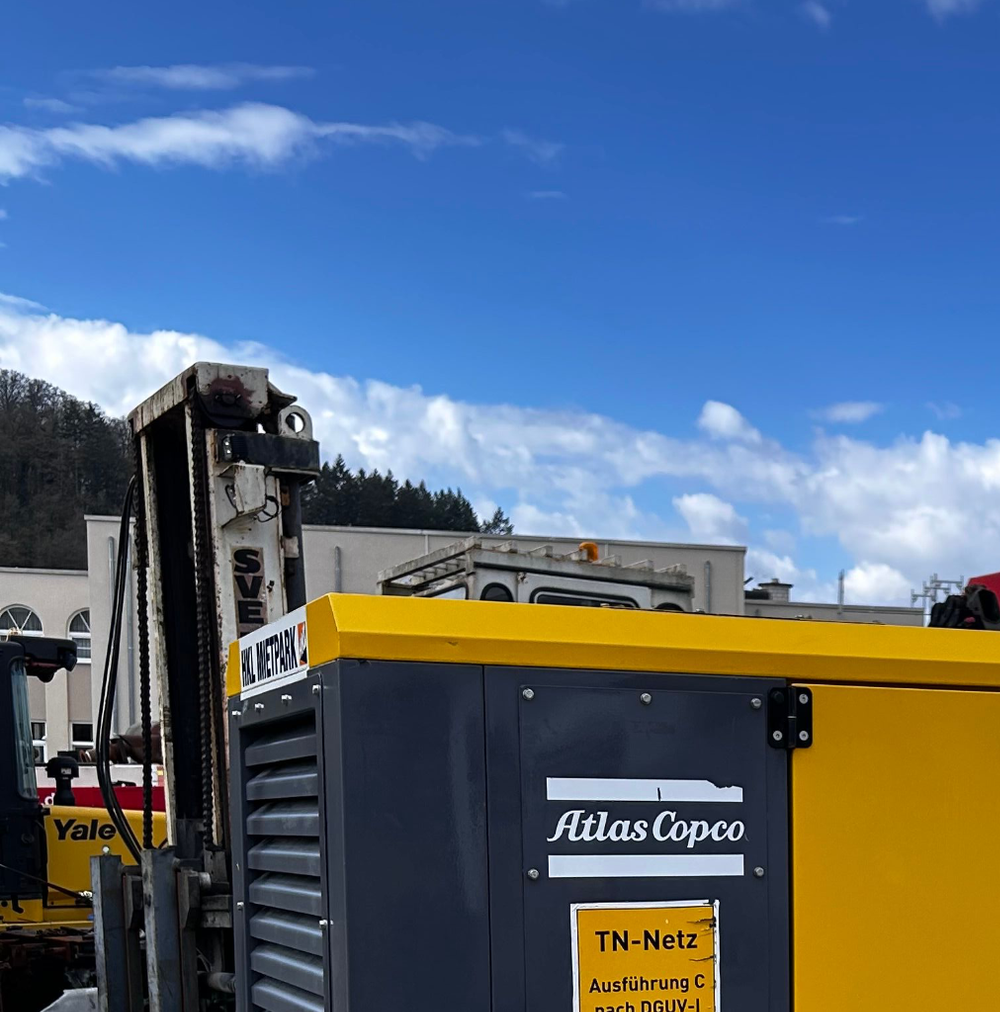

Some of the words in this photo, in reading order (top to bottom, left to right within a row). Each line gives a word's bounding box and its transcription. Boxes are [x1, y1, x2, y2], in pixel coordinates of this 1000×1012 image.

[233, 549, 265, 640] SVE
[241, 646, 256, 687] HKL
[256, 626, 298, 682] MIETPARK
[53, 818, 117, 841] Yale
[546, 809, 649, 842] Atlas
[652, 810, 745, 849] Copco
[594, 929, 698, 952] TN-Netz
[589, 976, 689, 994] Ausführung
[694, 973, 706, 989] C
